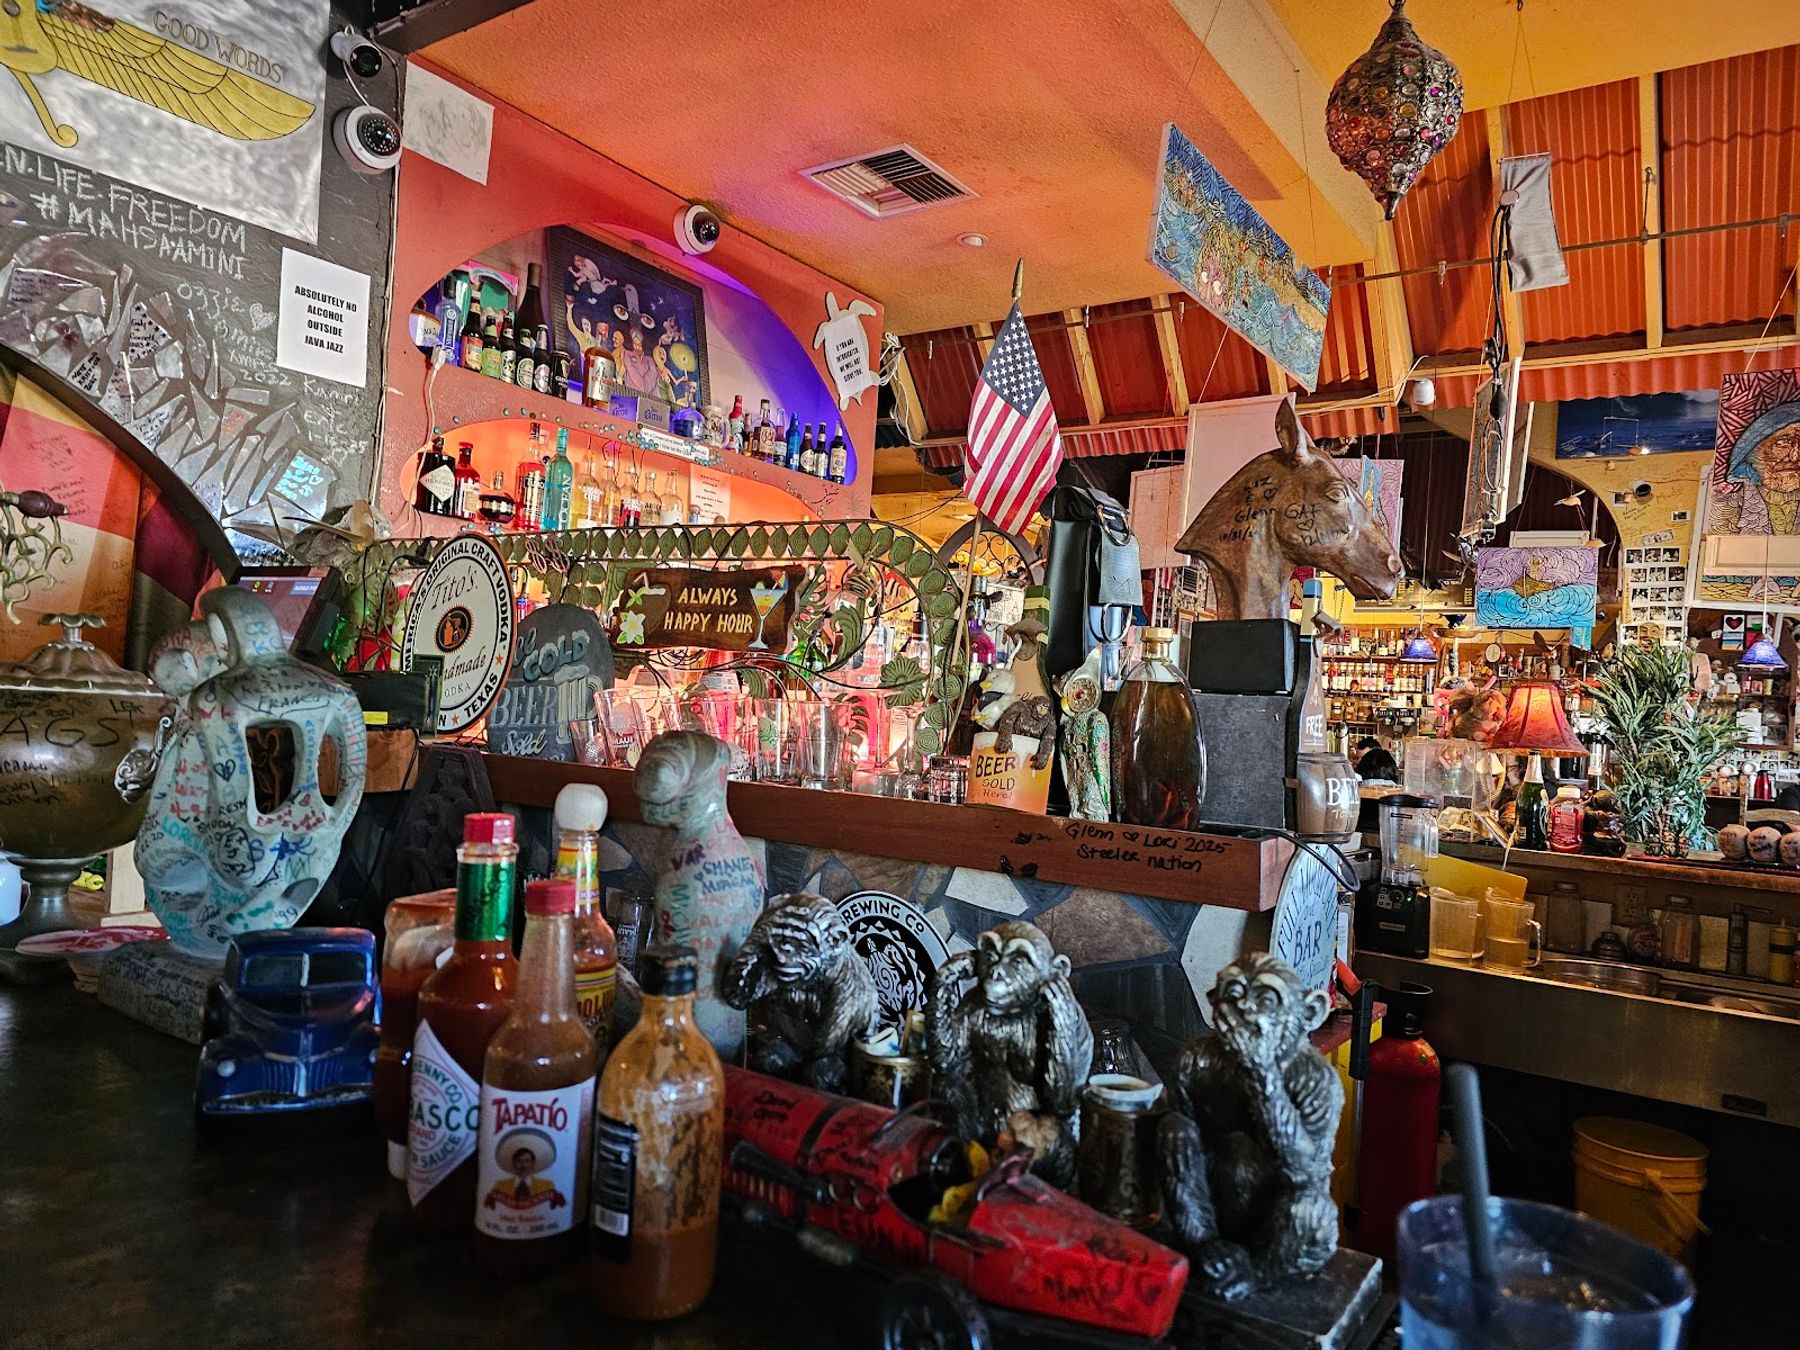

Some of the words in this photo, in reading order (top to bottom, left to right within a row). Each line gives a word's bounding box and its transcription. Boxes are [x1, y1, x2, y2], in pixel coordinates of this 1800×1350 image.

[153, 10, 210, 50] GOOD
[213, 34, 286, 83] WORDS
[108, 183, 246, 254] FREEDOM
[295, 285, 345, 309] ABSOLUTELY
[346, 301, 357, 313] NO
[307, 304, 344, 323] ALCOHOL
[307, 319, 344, 338] OUTSIDE
[304, 335, 326, 349] JAVA
[326, 341, 344, 354] JAZZ
[426, 541, 471, 586] ORIGINAL
[471, 541, 500, 577] CRAFT
[495, 577, 509, 642] VODKA
[678, 587, 738, 607] ALWAYS
[664, 611, 712, 633] HAPPY
[716, 612, 754, 634] HOUR
[523, 629, 591, 681] COLD
[444, 681, 472, 698] ODKA
[464, 672, 498, 718] TEXAS
[490, 685, 558, 728] BEER
[1306, 714, 1323, 738] FREE
[501, 728, 547, 757] Sold
[976, 754, 1016, 779] BEER
[982, 777, 1016, 791] SOLD
[1066, 822, 1115, 841] Glenn
[1184, 836, 1233, 854] 2025
[840, 899, 901, 927] REWING
[1293, 919, 1323, 969] BAR
[492, 1098, 568, 1134] TAPATÍO
[420, 1134, 461, 1169] SAUCE
